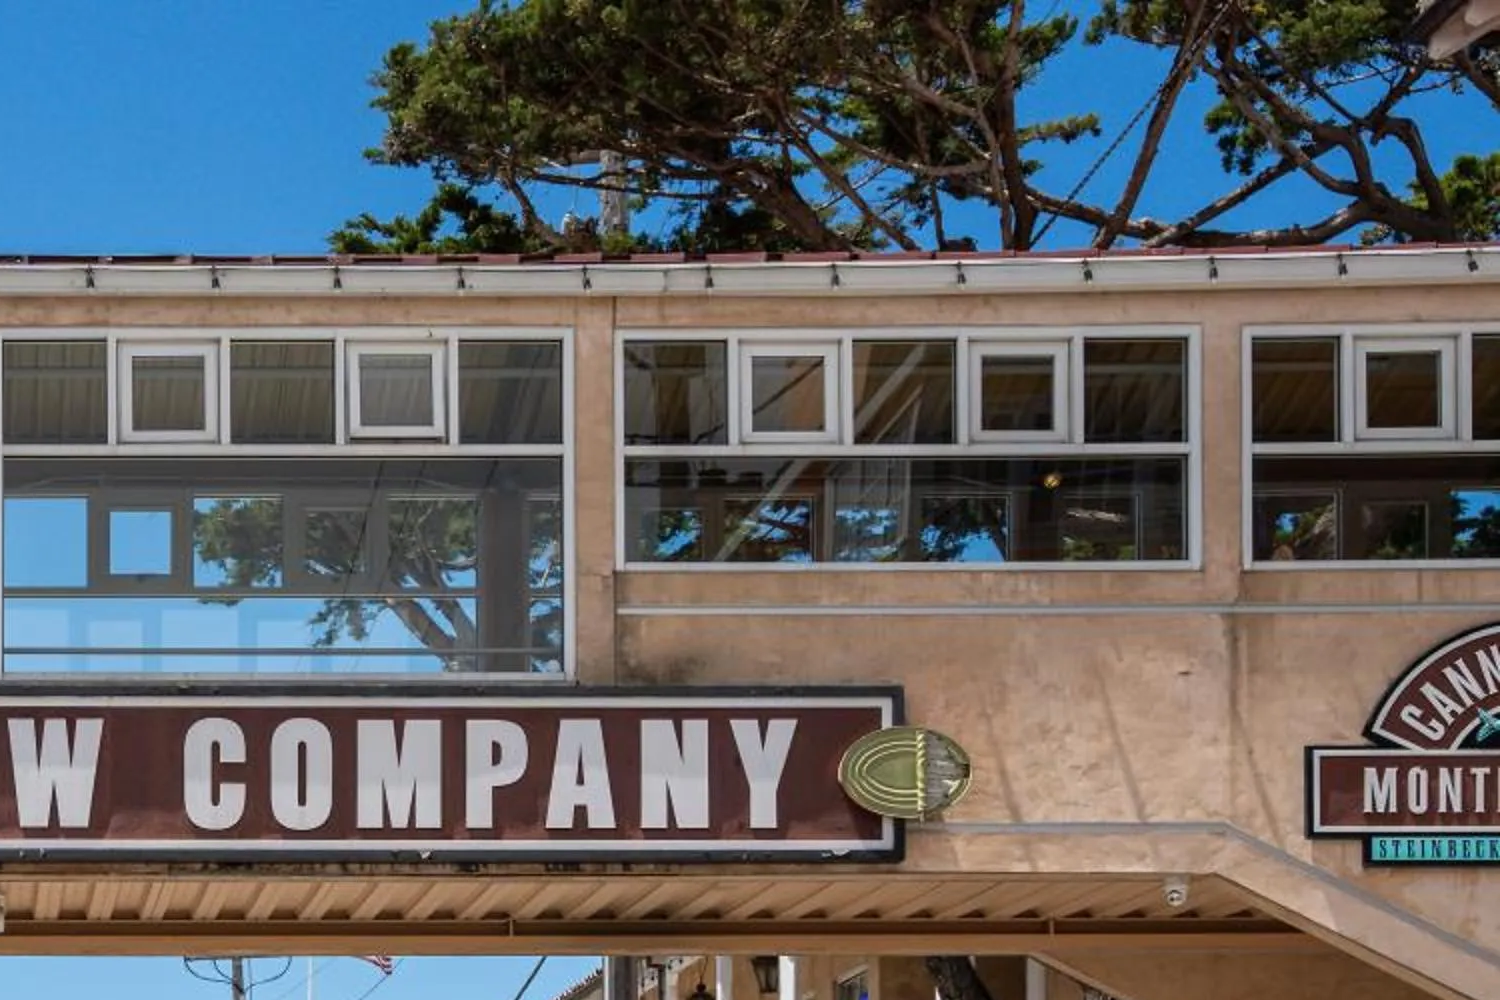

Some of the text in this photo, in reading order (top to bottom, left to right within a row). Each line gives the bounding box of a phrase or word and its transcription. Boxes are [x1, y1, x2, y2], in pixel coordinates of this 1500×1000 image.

[183, 717, 798, 831] COMPANY
[1363, 765, 1500, 815] MONT
[1379, 839, 1500, 858] STEINBECK
